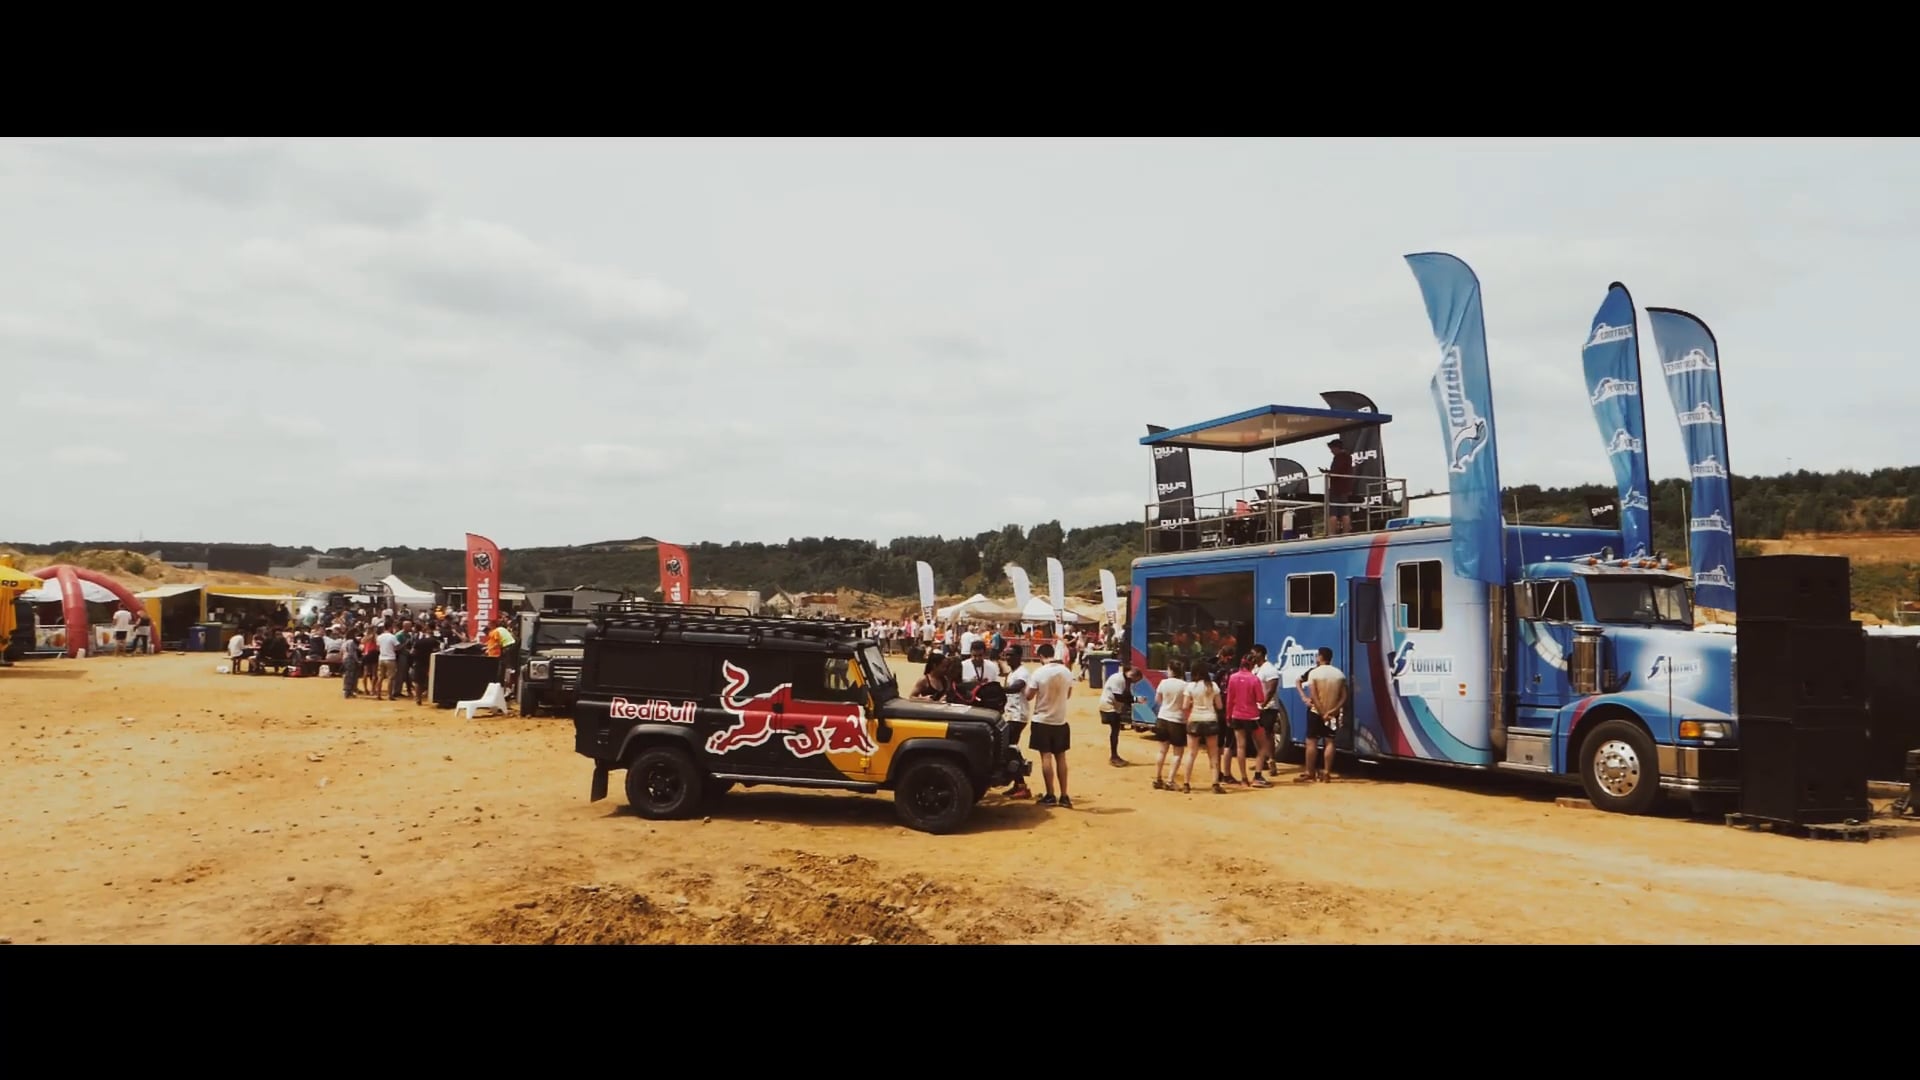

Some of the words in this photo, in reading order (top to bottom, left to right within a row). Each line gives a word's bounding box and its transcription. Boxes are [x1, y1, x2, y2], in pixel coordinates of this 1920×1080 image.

[1291, 653, 1318, 667] CONTA
[1411, 657, 1453, 673] CONTACT
[611, 698, 651, 719] Red
[654, 700, 697, 723] Bull
